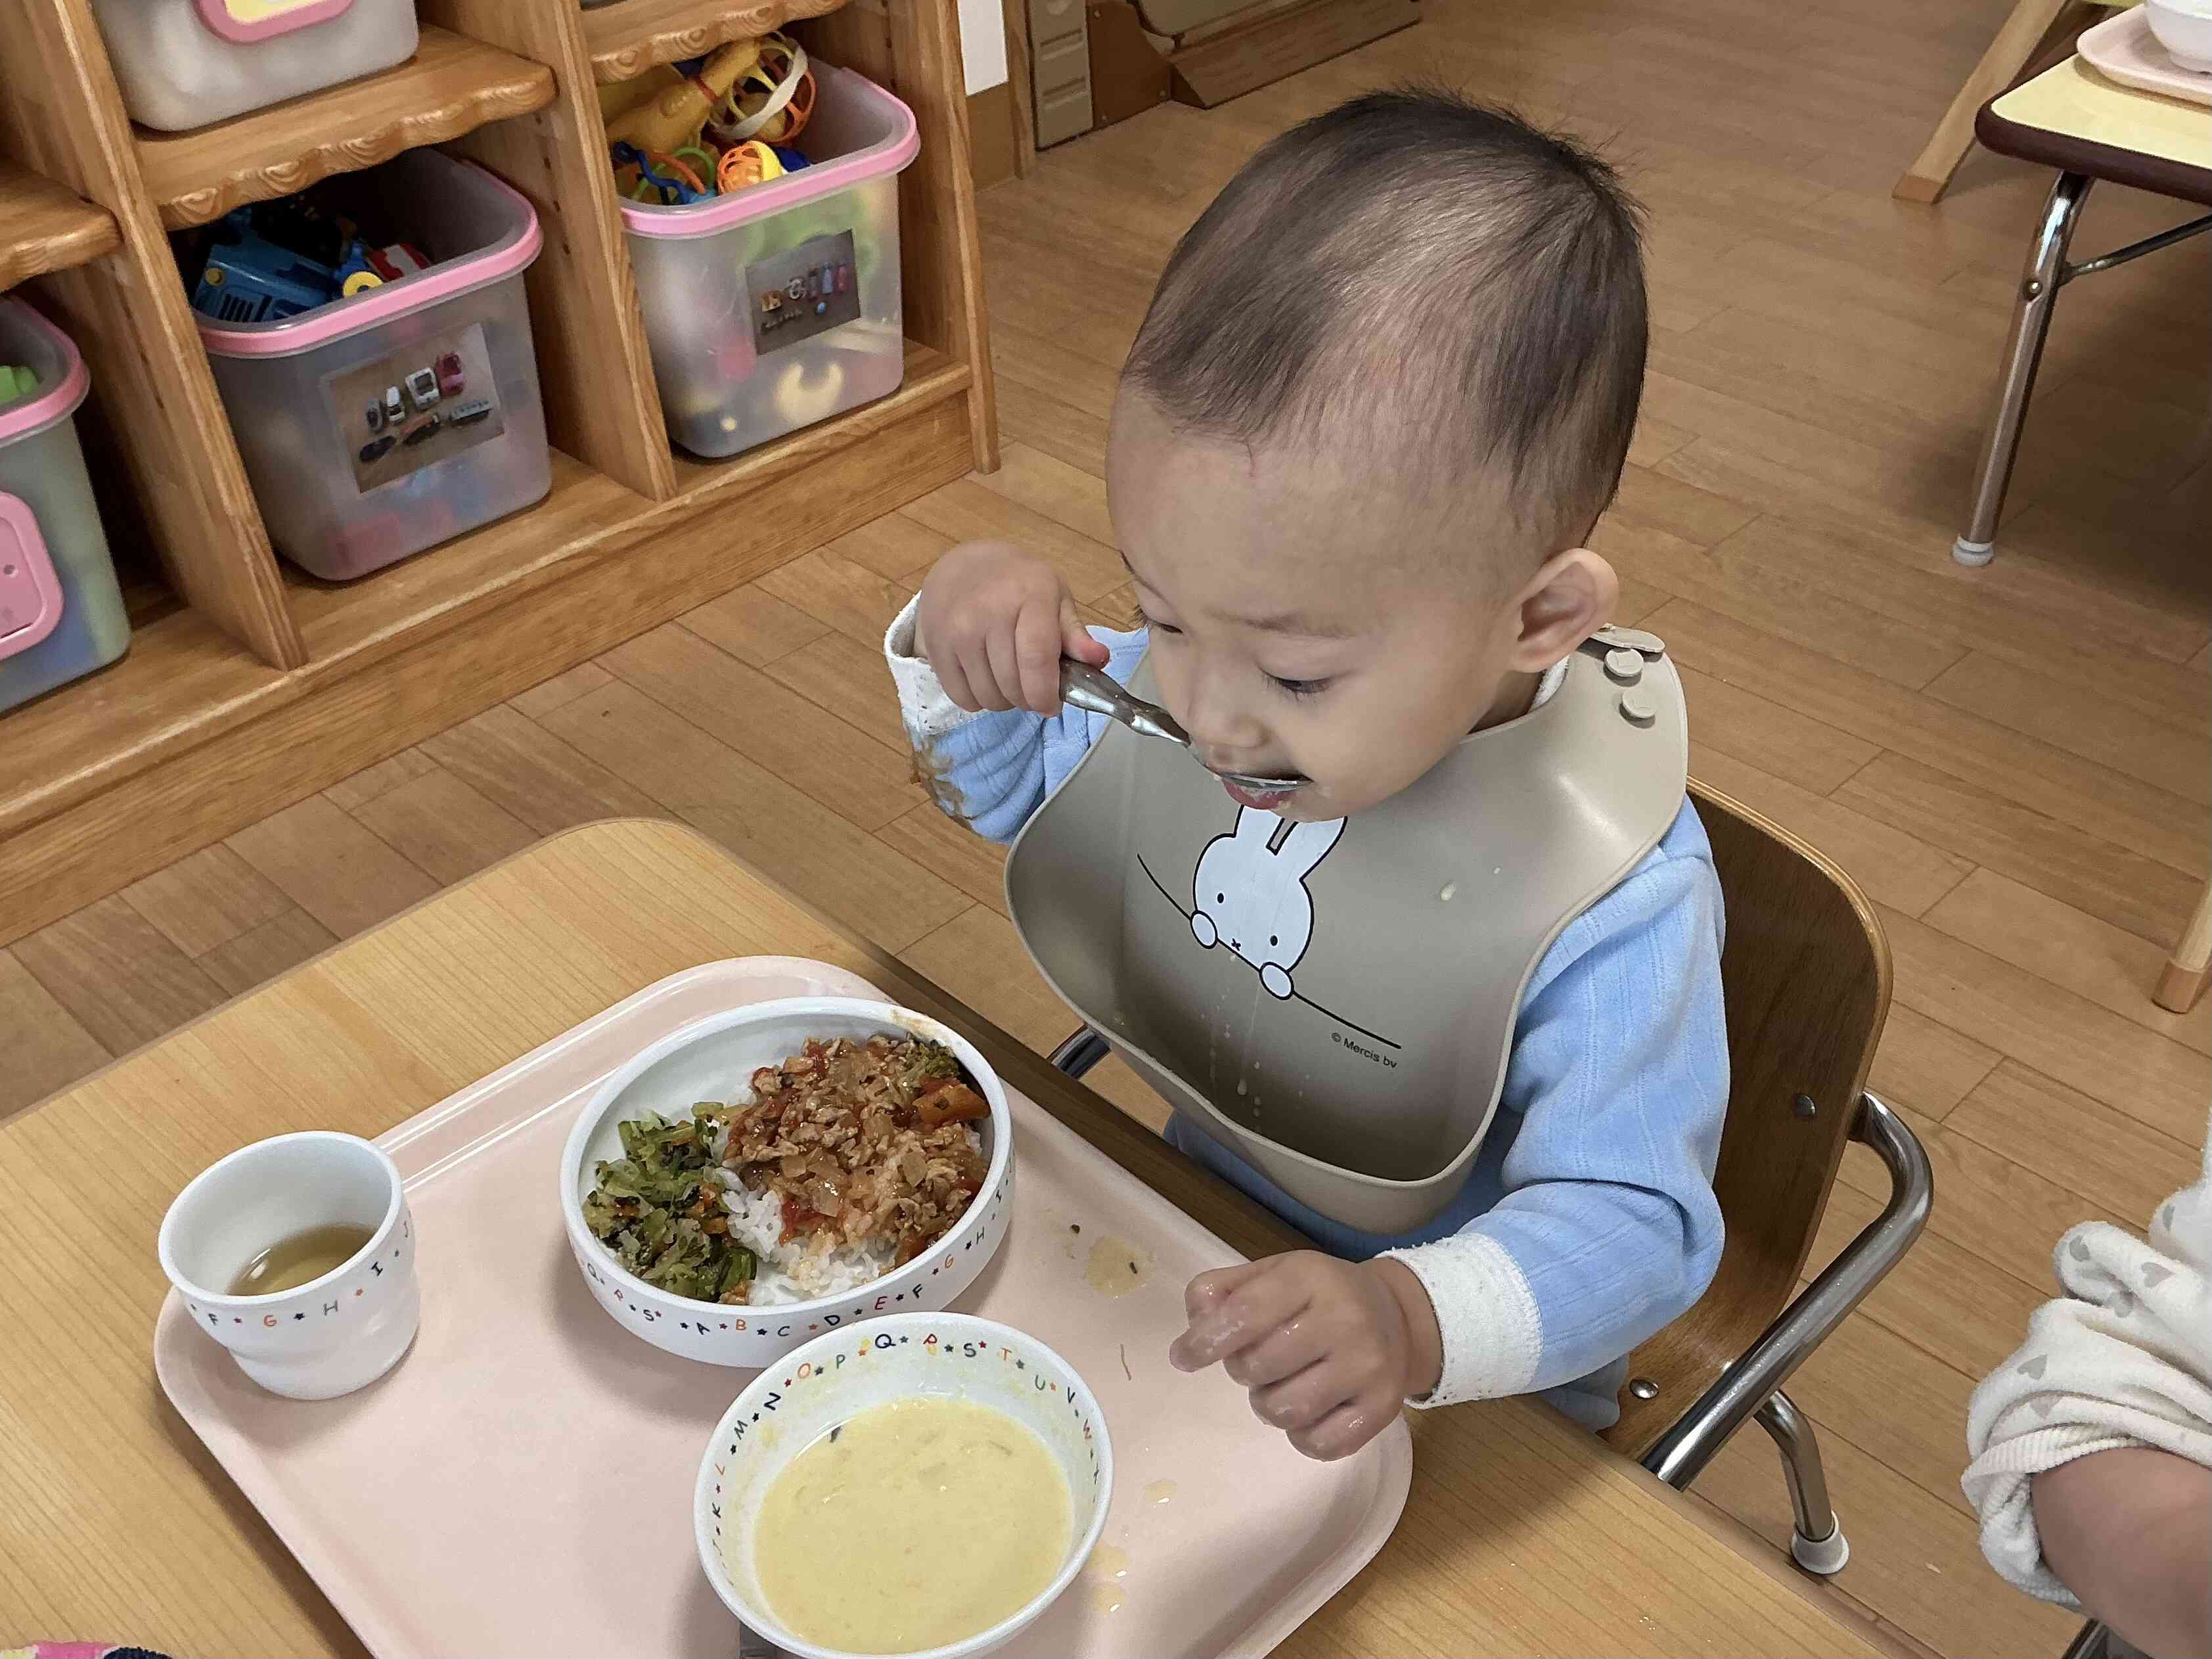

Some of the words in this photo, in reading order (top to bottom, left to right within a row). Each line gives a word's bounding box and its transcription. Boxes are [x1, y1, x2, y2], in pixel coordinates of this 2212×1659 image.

[1343, 1037, 1380, 1062] Mercis
[1383, 1056, 1397, 1068] bv
[263, 1315, 277, 1327] G
[323, 1300, 338, 1315] H
[371, 1261, 384, 1277] I
[587, 1263, 599, 1282] Q
[643, 1309, 655, 1322] S
[696, 1322, 710, 1335] A
[735, 1319, 746, 1330] B
[777, 1325, 790, 1336] C
[824, 1315, 841, 1326] D
[874, 1296, 888, 1310] E
[912, 1283, 923, 1299] F
[945, 1254, 954, 1269] G
[976, 1226, 985, 1244] H
[711, 1502, 721, 1518] K
[734, 1420, 748, 1441] M
[763, 1392, 782, 1411] N
[798, 1362, 811, 1378] O
[836, 1354, 846, 1369] P
[874, 1334, 896, 1349] Q
[923, 1333, 937, 1345] R
[963, 1342, 976, 1357] S
[1001, 1347, 1012, 1361] T
[1035, 1375, 1045, 1390] U
[1067, 1386, 1076, 1403] V
